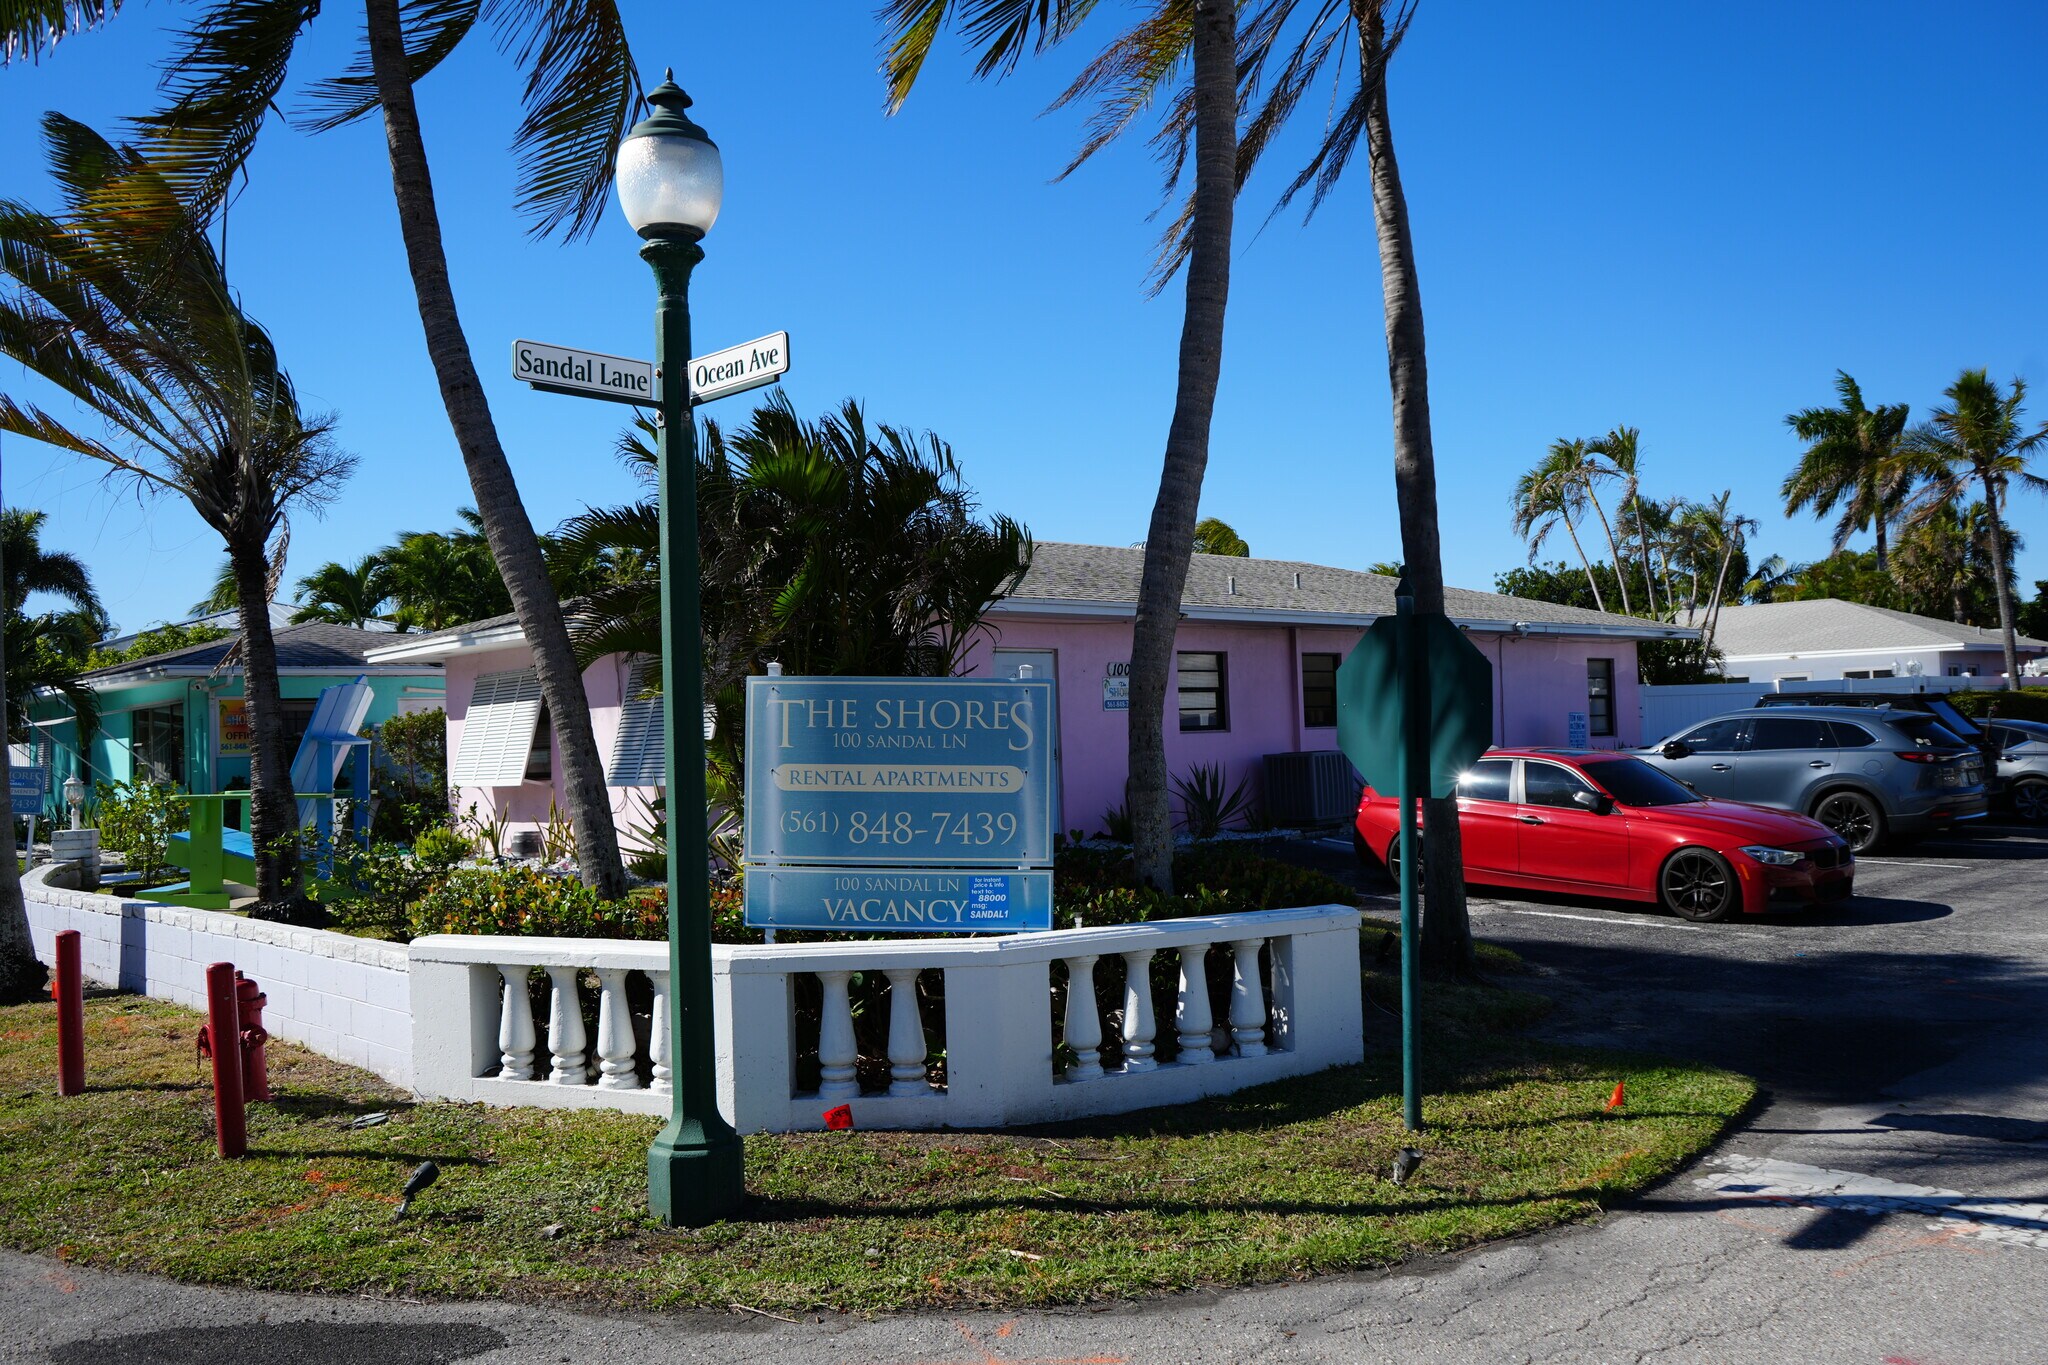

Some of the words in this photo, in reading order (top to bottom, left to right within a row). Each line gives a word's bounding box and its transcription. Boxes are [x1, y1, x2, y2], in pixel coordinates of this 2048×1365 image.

[519, 349, 592, 383] Sandal
[600, 362, 649, 391] Lane
[695, 359, 745, 388] Ocean
[748, 347, 780, 373] Ave
[766, 699, 858, 748] THE
[874, 699, 1034, 751] SHORES
[832, 732, 861, 748] 100
[866, 734, 935, 749] SANDAL
[942, 734, 967, 749] LN
[789, 769, 866, 786] RENTAL
[873, 771, 1009, 787] APARTMENTS
[780, 811, 840, 835] (561)
[848, 811, 1017, 845] 848-7439
[834, 877, 860, 891] 100
[865, 878, 932, 892] SANDAL
[938, 878, 960, 892] LN
[978, 894, 1006, 902] 88000
[822, 898, 969, 923] VACANCY
[970, 910, 1009, 918] SANDAL1
